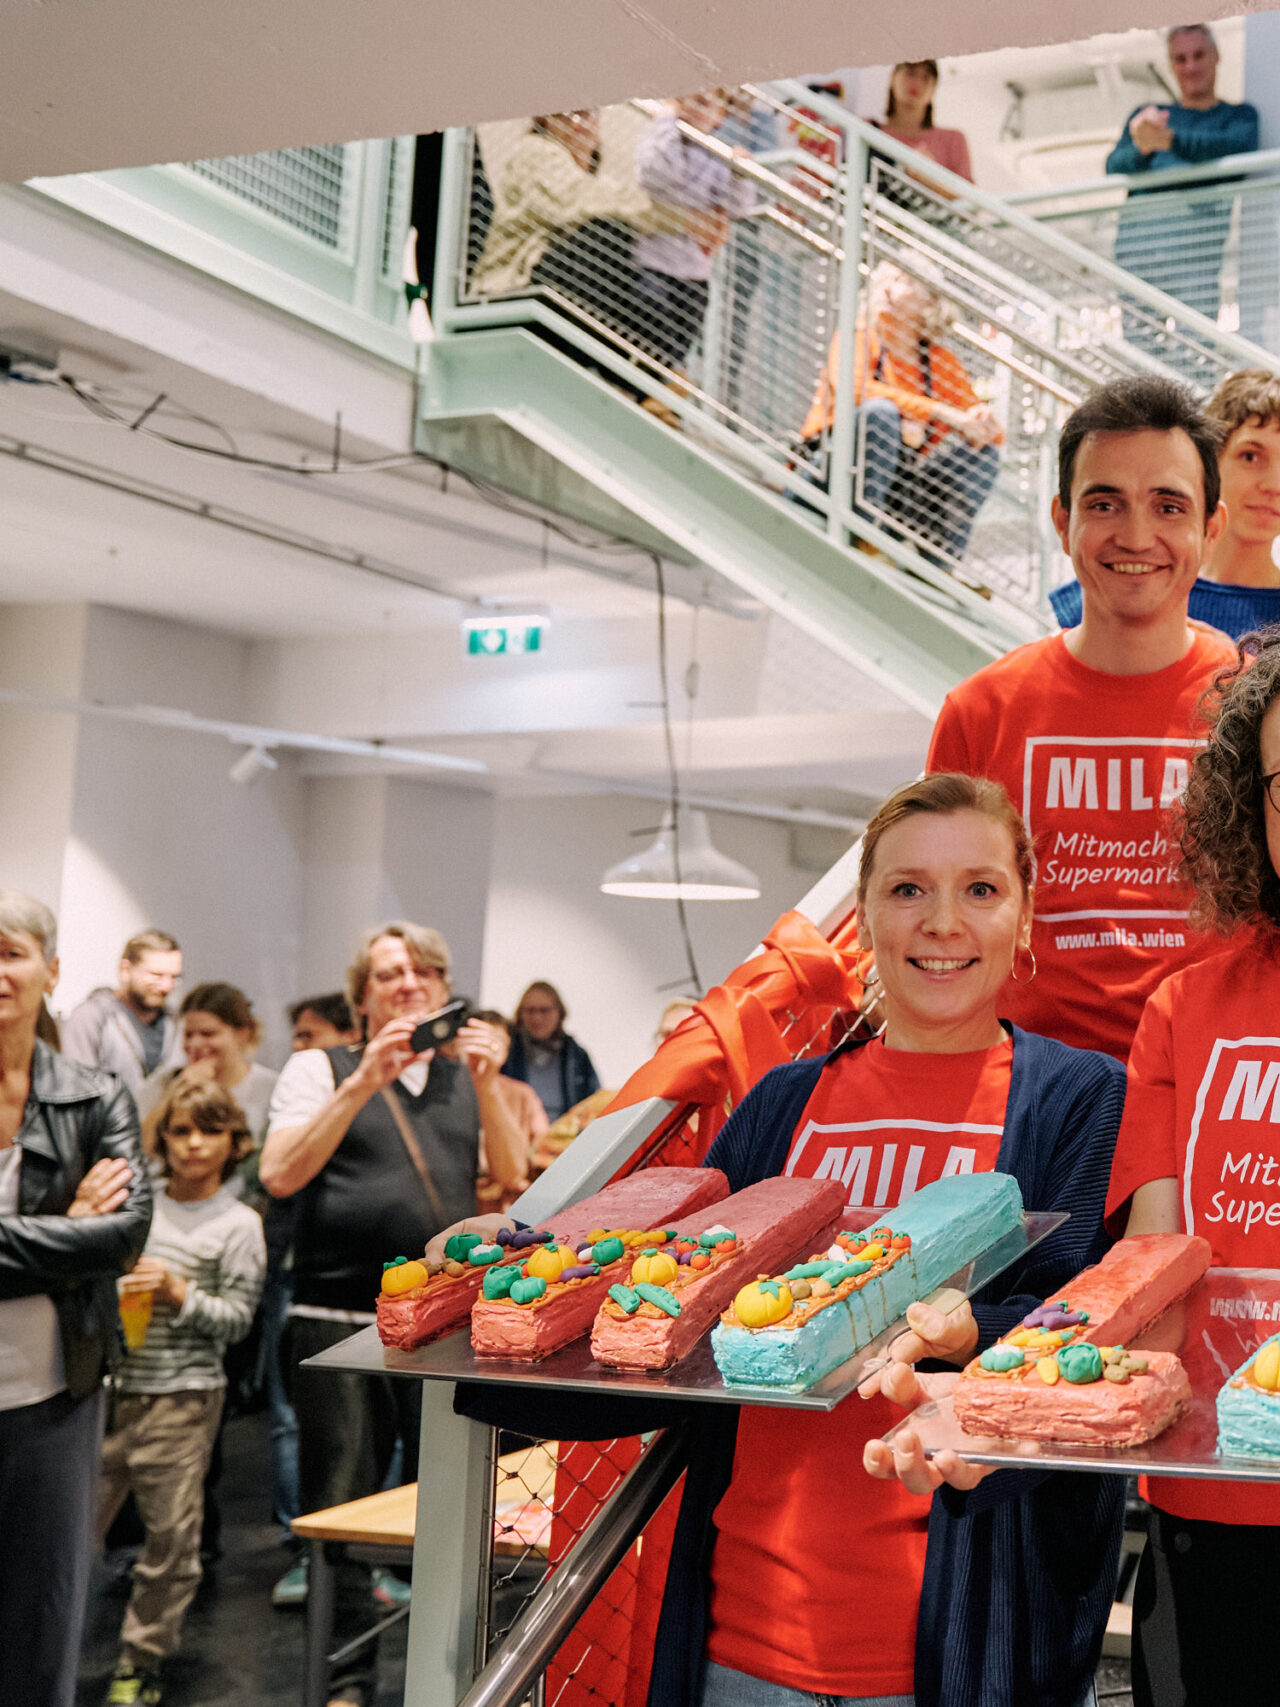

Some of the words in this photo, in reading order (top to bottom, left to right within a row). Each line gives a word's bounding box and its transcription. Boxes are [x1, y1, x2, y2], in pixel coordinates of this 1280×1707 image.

[1046, 757, 1188, 811] MILA
[1053, 830, 1182, 858] Mitmach-
[1042, 860, 1180, 892] Supermark
[1055, 928, 1186, 950] www.mila.wien
